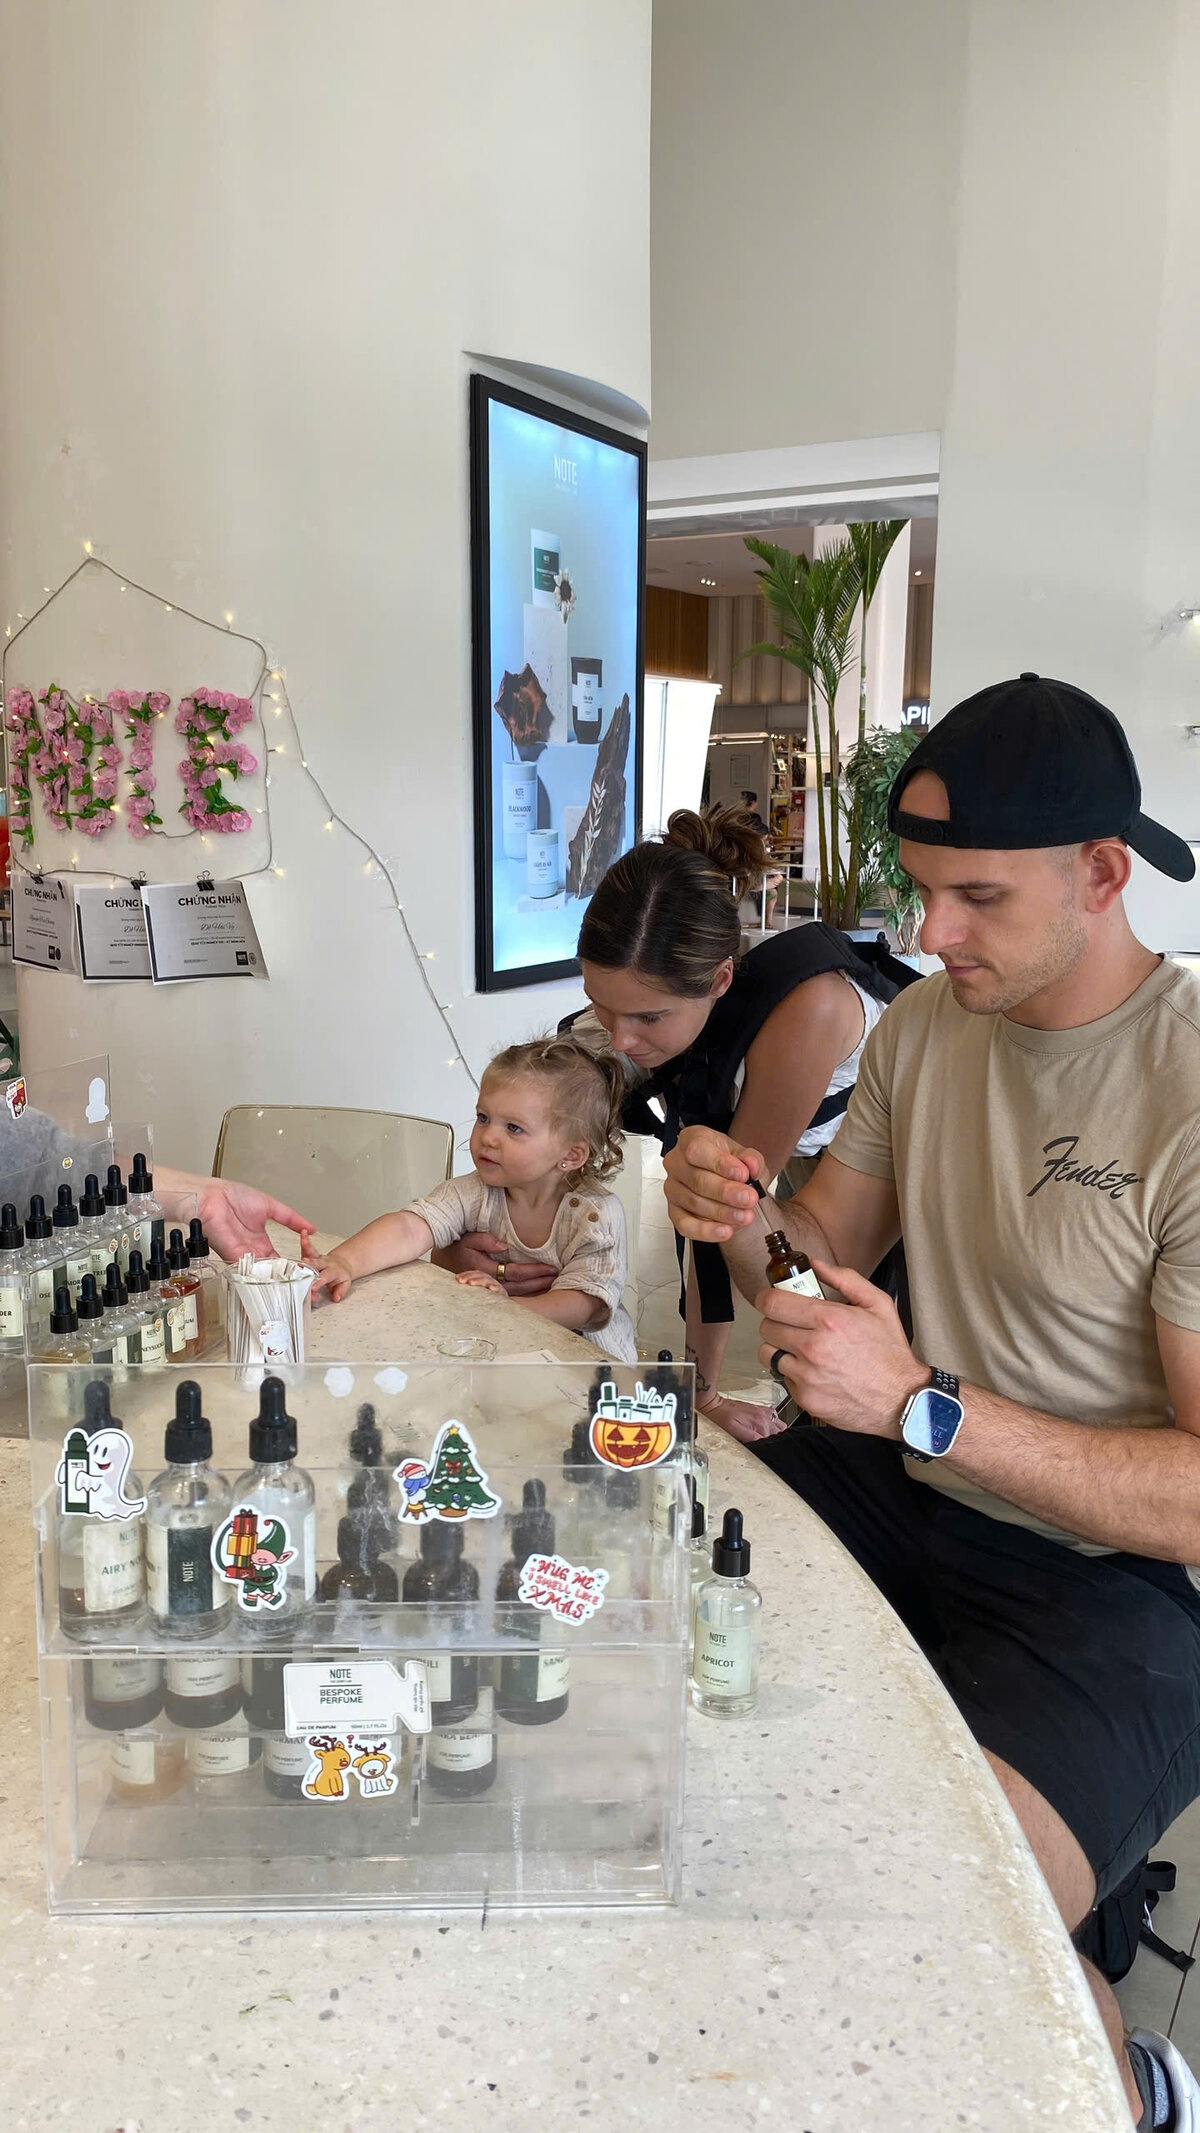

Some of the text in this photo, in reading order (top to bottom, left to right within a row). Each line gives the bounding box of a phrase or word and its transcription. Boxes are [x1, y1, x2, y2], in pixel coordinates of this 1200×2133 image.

[553, 455, 578, 485] NOTE
[178, 894, 216, 907] CHỨNG
[1026, 1136, 1139, 1200] Fender
[101, 1563, 127, 1576] AIRY
[182, 1561, 194, 1582] NOTE
[526, 1585, 586, 1619] XMAS
[709, 1632, 727, 1644] NOTE
[701, 1654, 735, 1667] APRICOT
[330, 1668, 352, 1679] NOTE
[320, 1688, 362, 1697] BESPOKE
[320, 1696, 363, 1704] PERFUME
